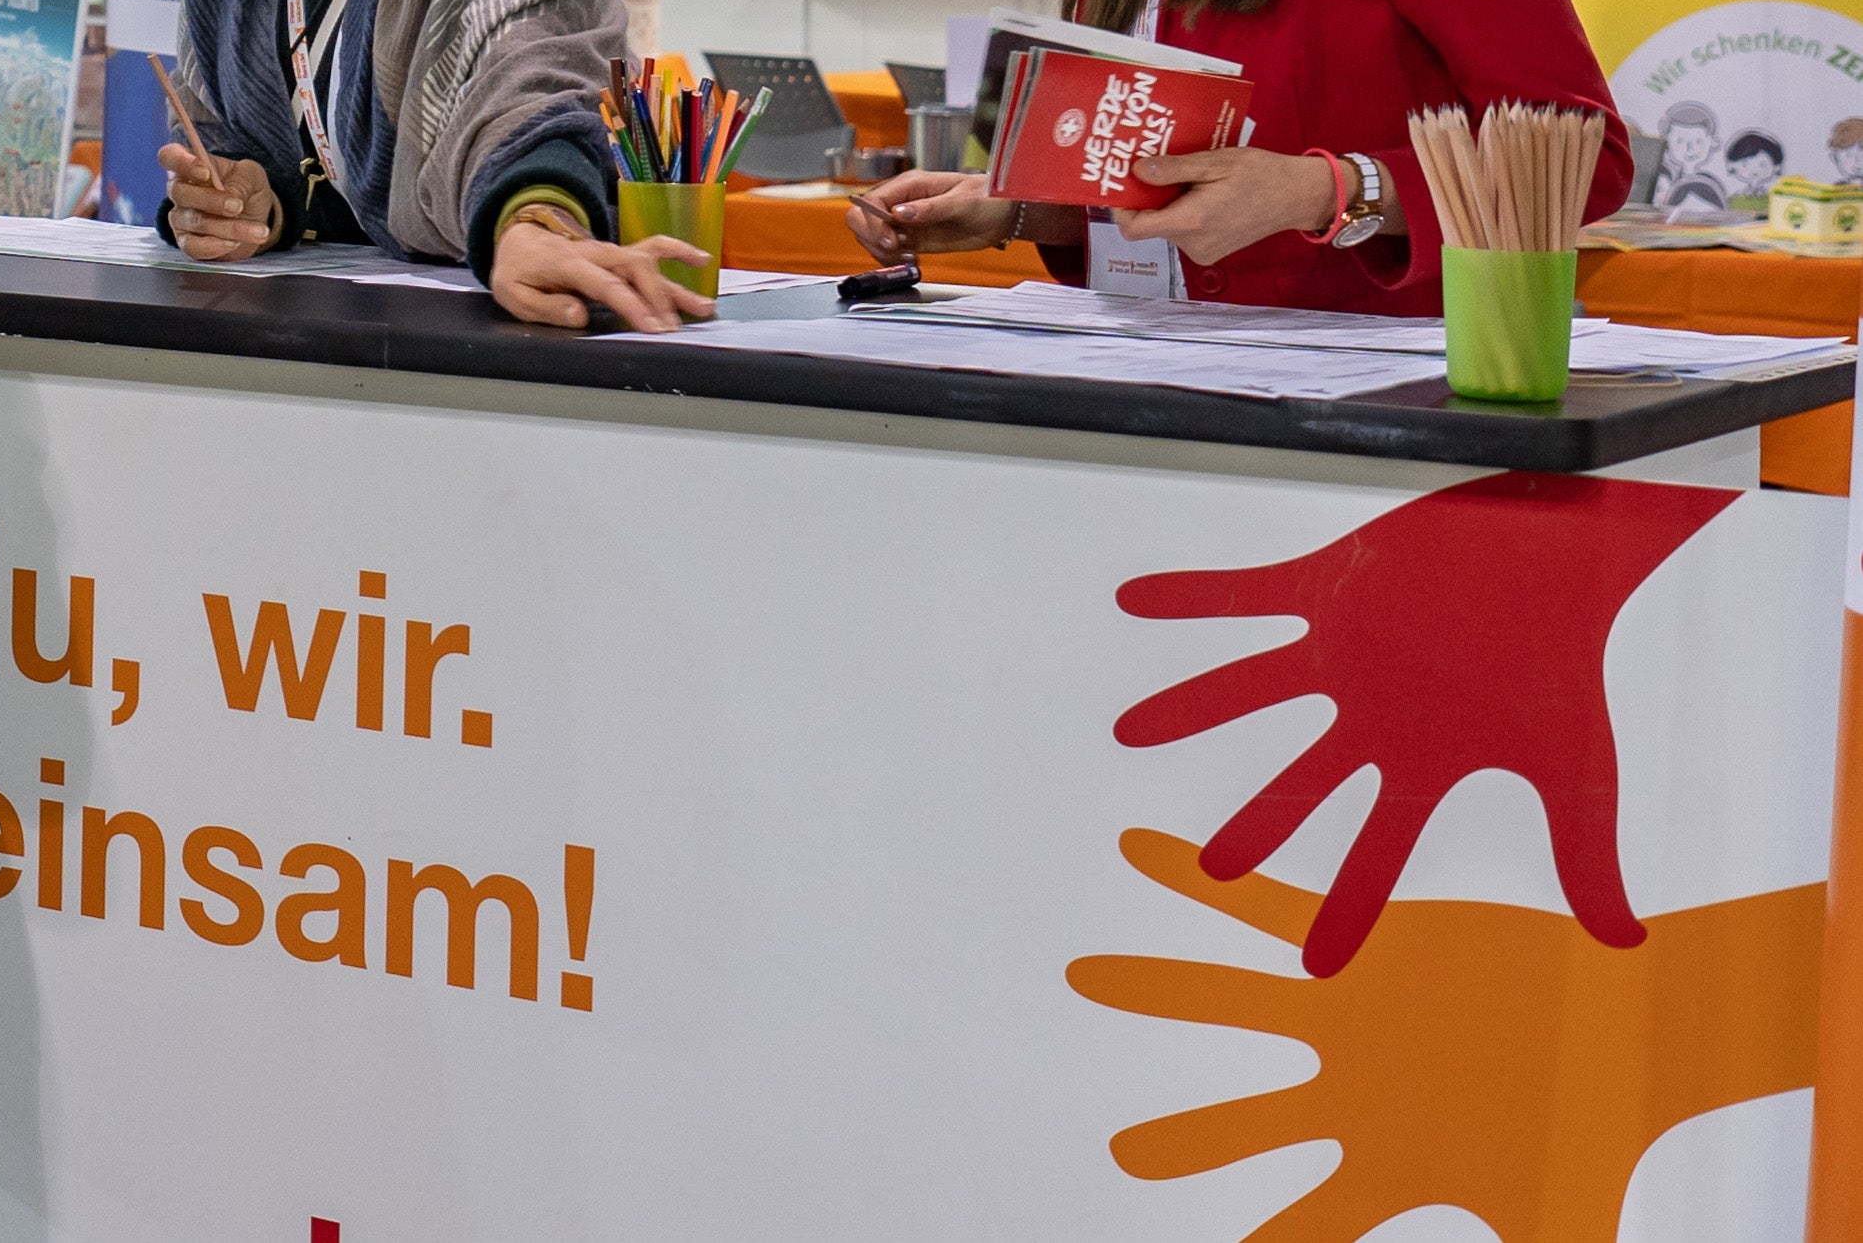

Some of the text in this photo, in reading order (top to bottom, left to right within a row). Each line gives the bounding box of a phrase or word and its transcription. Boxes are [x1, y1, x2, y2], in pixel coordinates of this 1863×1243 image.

[1643, 28, 1863, 96] Wir schenken ZE
[1080, 74, 1131, 182] WERDE
[1099, 71, 1158, 196] TEIL VON
[201, 570, 493, 750] wir.
